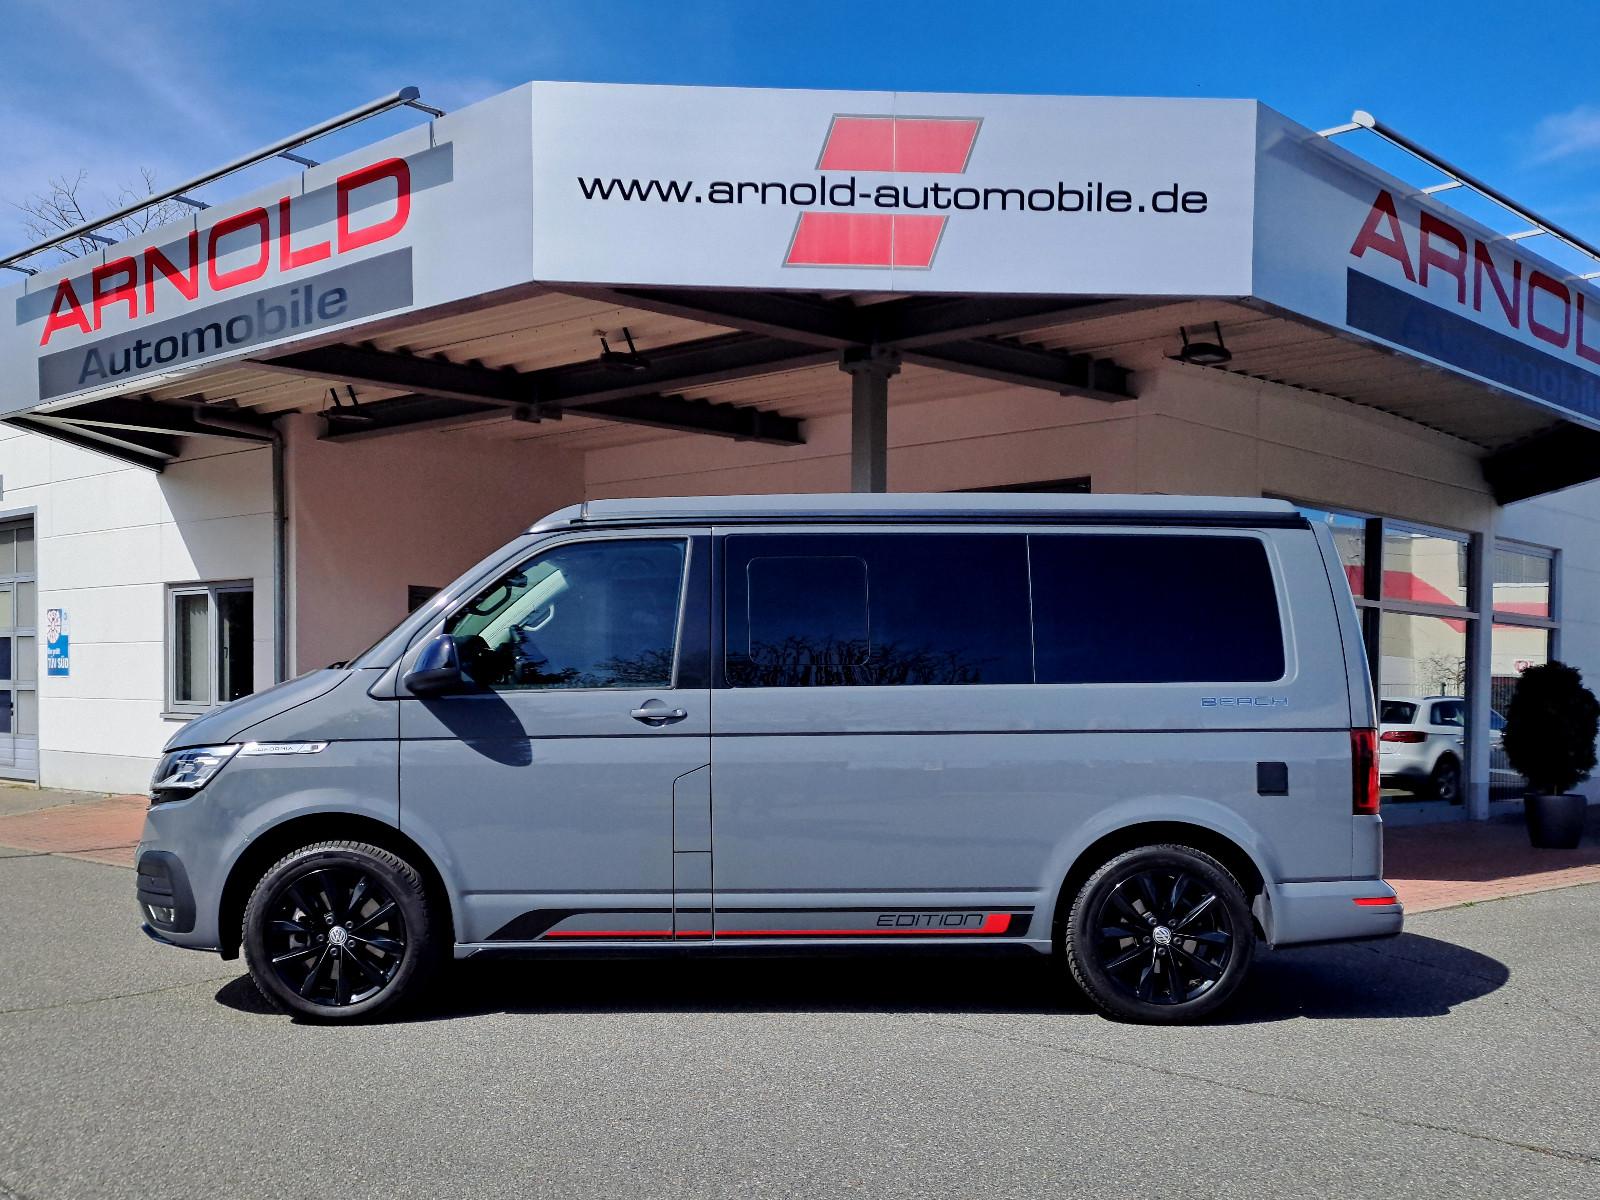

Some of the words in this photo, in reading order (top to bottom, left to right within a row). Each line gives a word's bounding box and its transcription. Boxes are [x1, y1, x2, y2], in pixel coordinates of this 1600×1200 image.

[577, 175, 1208, 214] www.arnold-automobile.de
[39, 157, 412, 347] ARNOLD
[77, 284, 348, 385] Automobile
[57, 655, 69, 668] SÜD
[1201, 697, 1288, 707] BEACH
[876, 913, 984, 927] EDITION
